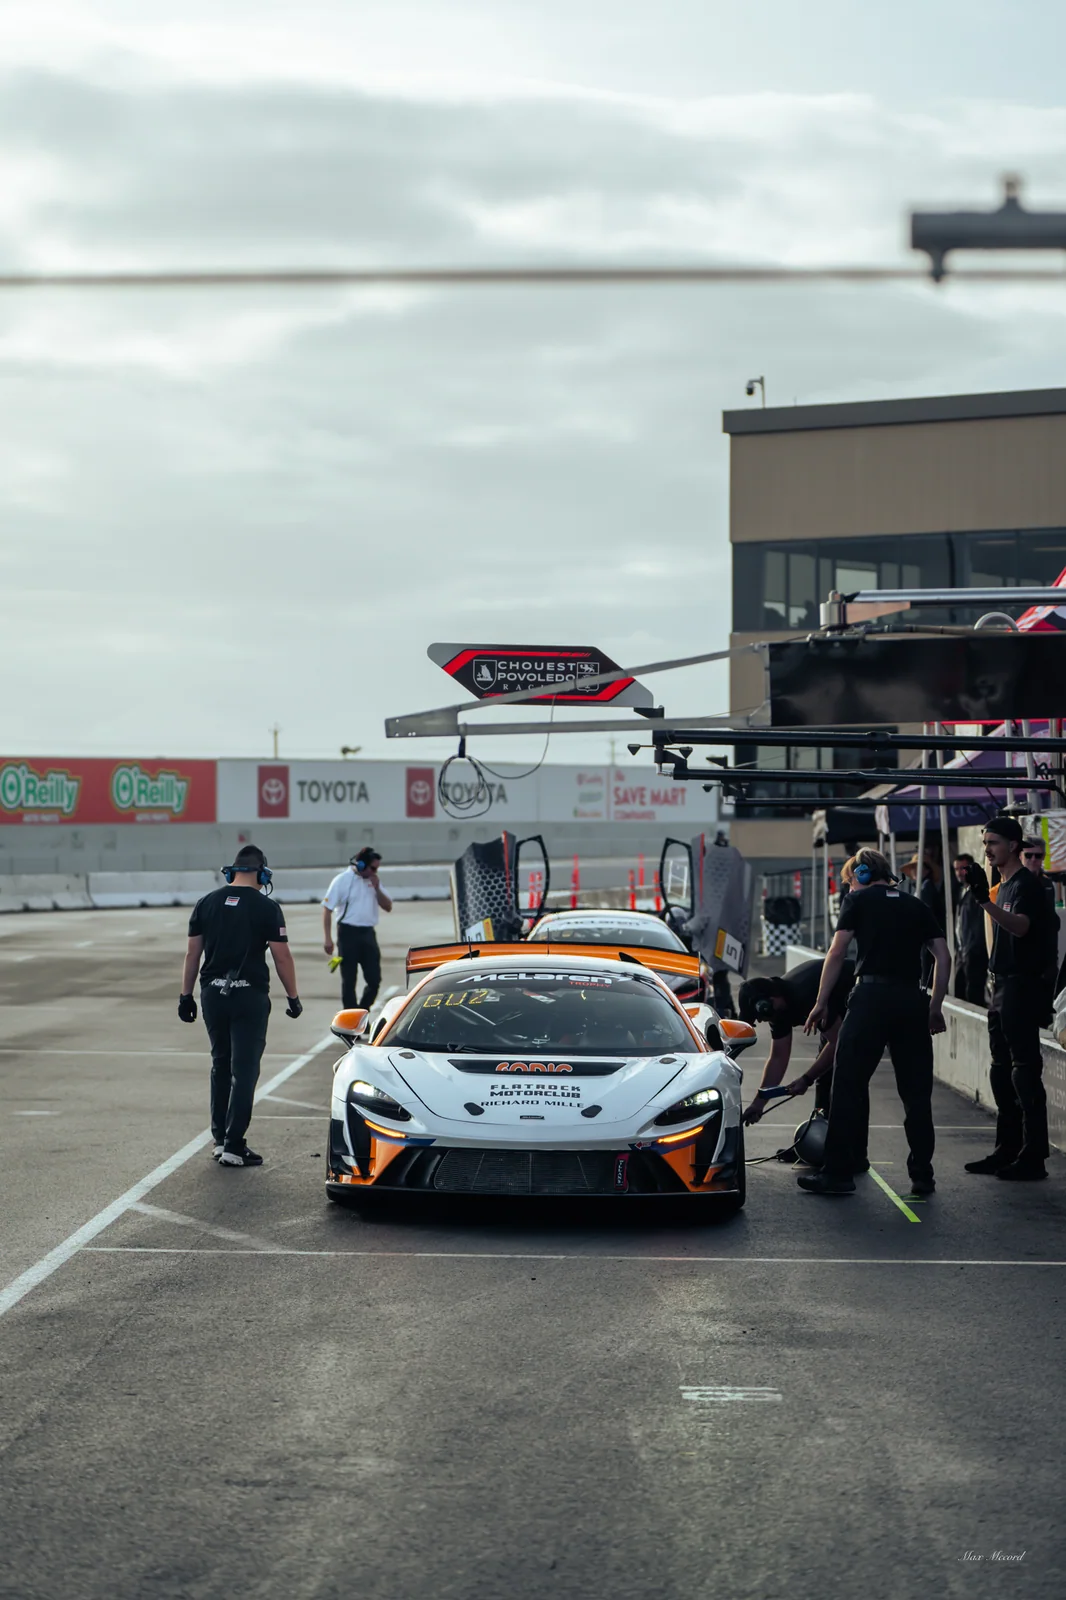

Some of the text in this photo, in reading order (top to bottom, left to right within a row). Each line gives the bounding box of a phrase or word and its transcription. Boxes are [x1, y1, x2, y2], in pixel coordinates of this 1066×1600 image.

[497, 661, 577, 672] CHOUEST
[497, 672, 576, 682] POVOLEDO
[1, 766, 78, 812] O'Reilly
[113, 767, 188, 812] O'Reilly
[297, 780, 369, 803] TOYOTA
[443, 782, 508, 804] TOYOTA
[613, 786, 647, 806] SAVE
[650, 787, 687, 806] MART
[456, 973, 612, 985] McLaren
[490, 1084, 581, 1092] FLATROCK
[490, 1090, 581, 1099] MOTORCLUB
[544, 1100, 585, 1108] MILLE
